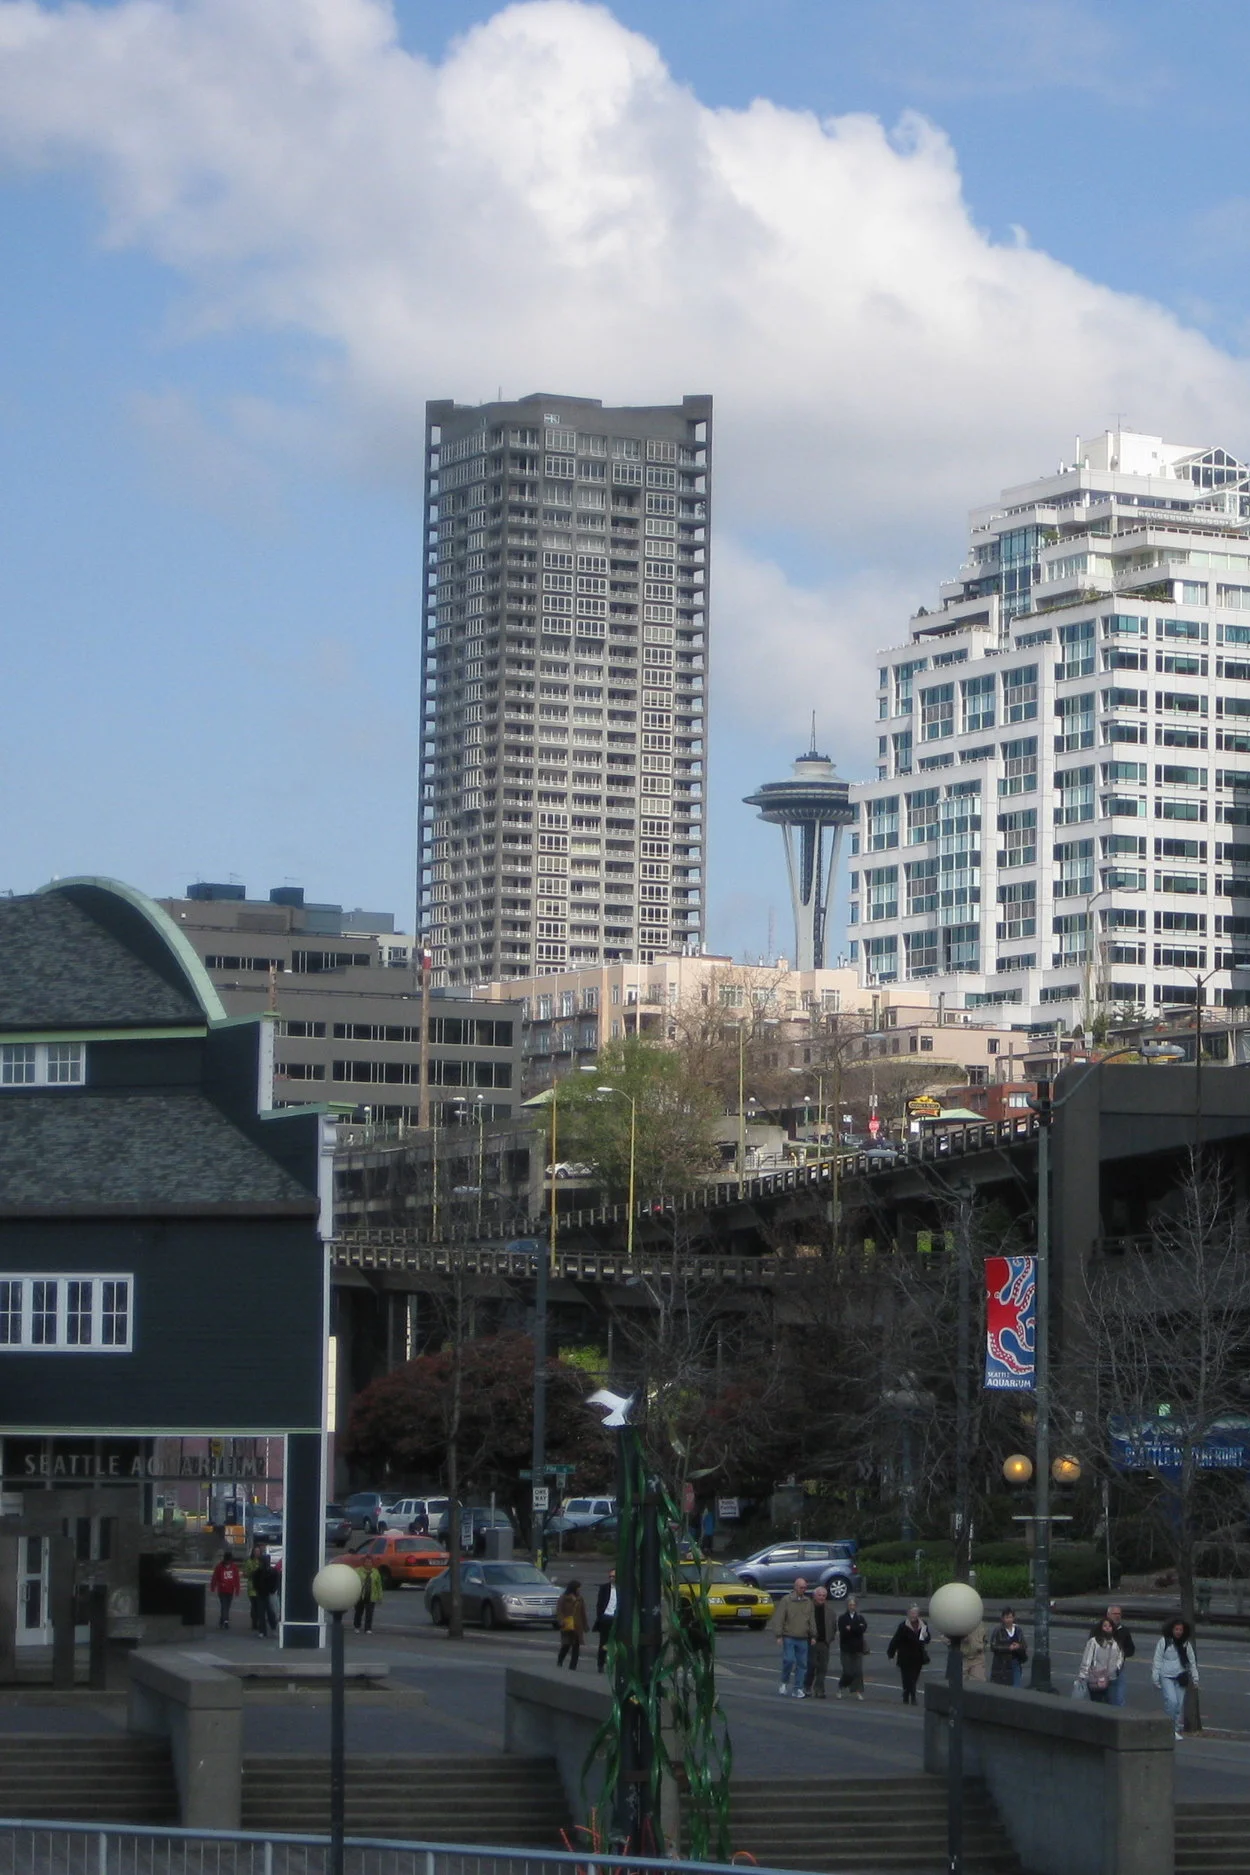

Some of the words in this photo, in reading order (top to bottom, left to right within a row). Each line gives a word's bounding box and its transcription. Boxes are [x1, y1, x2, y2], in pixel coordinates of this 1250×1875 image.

[24, 1454, 119, 1476] SEATTLE
[131, 1454, 257, 1477] AQARIUM
[1173, 1446, 1243, 1467] WTERFRONT
